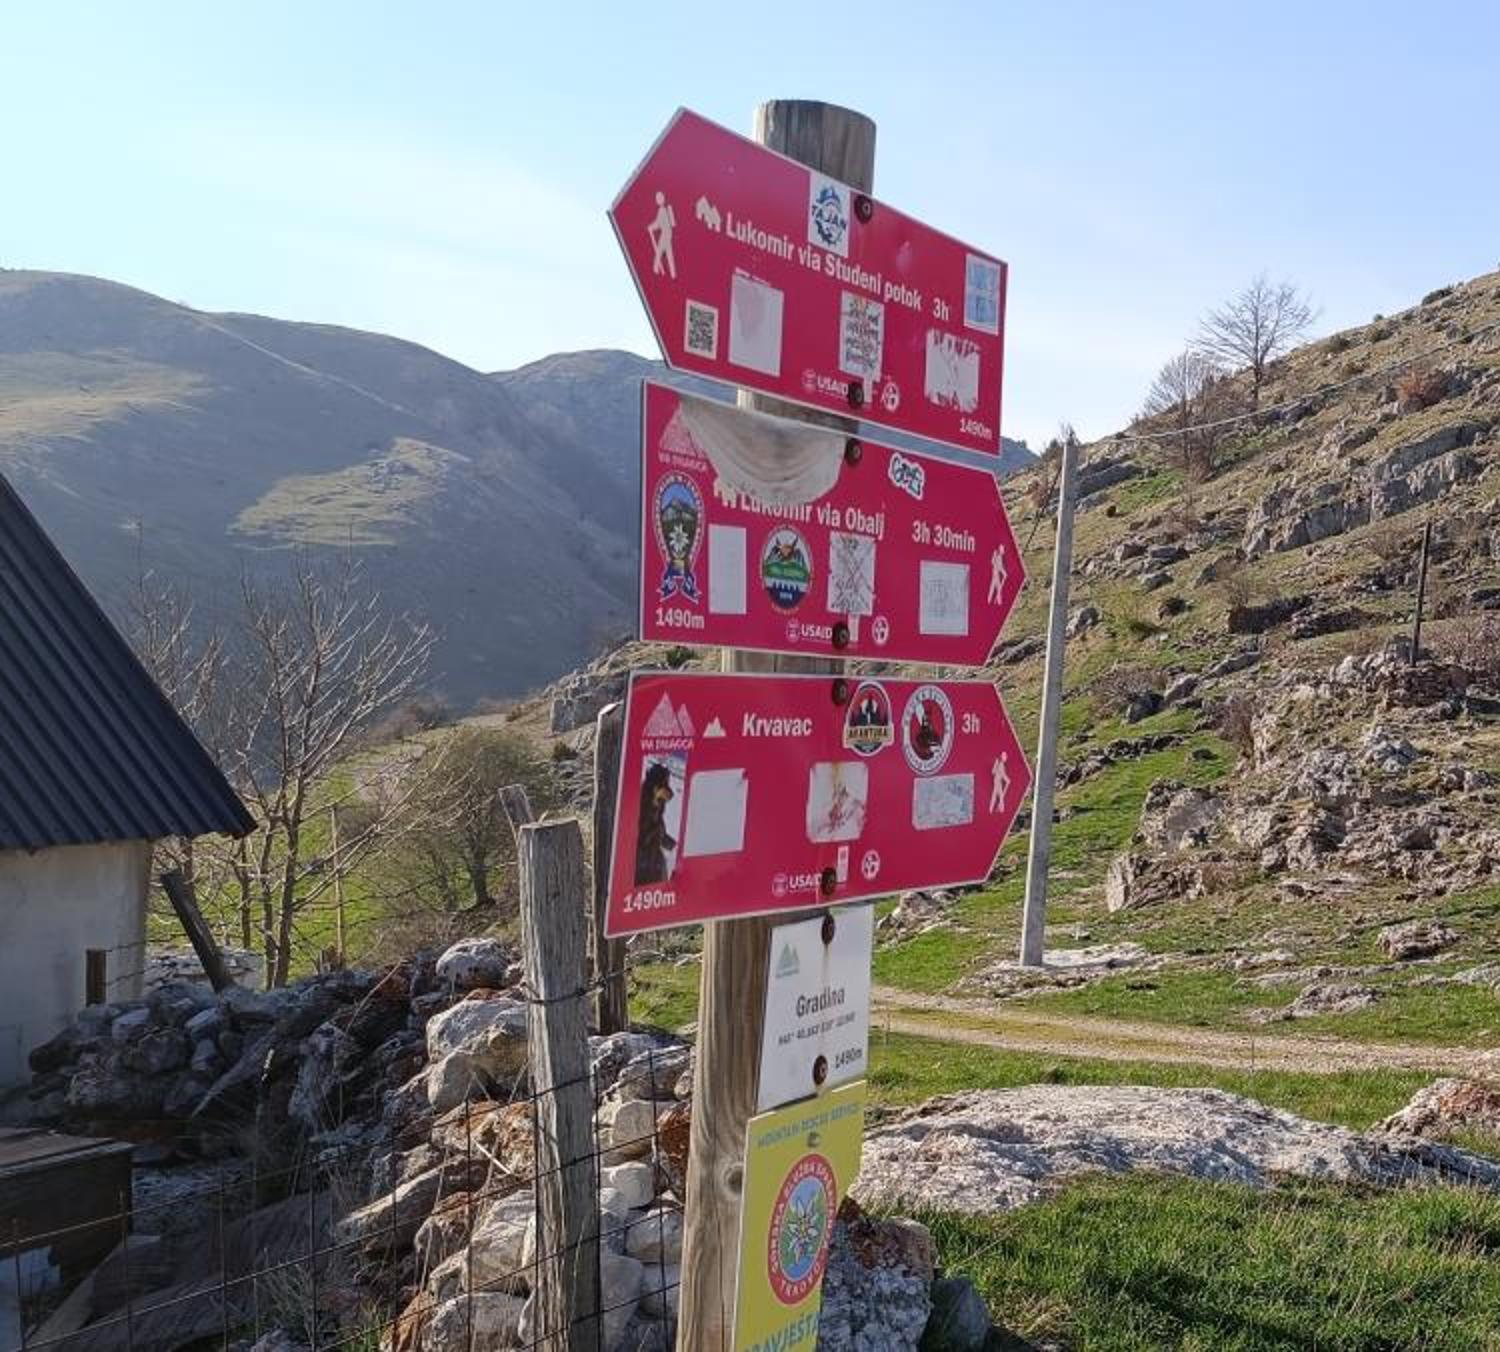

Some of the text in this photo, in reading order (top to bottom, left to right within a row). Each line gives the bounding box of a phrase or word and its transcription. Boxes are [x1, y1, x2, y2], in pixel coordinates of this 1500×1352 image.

[726, 213, 950, 321] Lukomir via Studeni potok 3h
[817, 375, 848, 397] USAID
[959, 416, 993, 439] 1490m
[740, 492, 885, 541] Lukomir via Obalj
[912, 520, 975, 551] 3h 30min
[655, 608, 705, 629] 1490m
[801, 624, 833, 640] USAID
[742, 712, 813, 737] Krvavac
[961, 713, 981, 734] 3h
[789, 873, 822, 889] USAID
[623, 891, 676, 913] 1490m
[796, 986, 846, 1018] Gradina
[835, 1047, 863, 1070] 1490m
